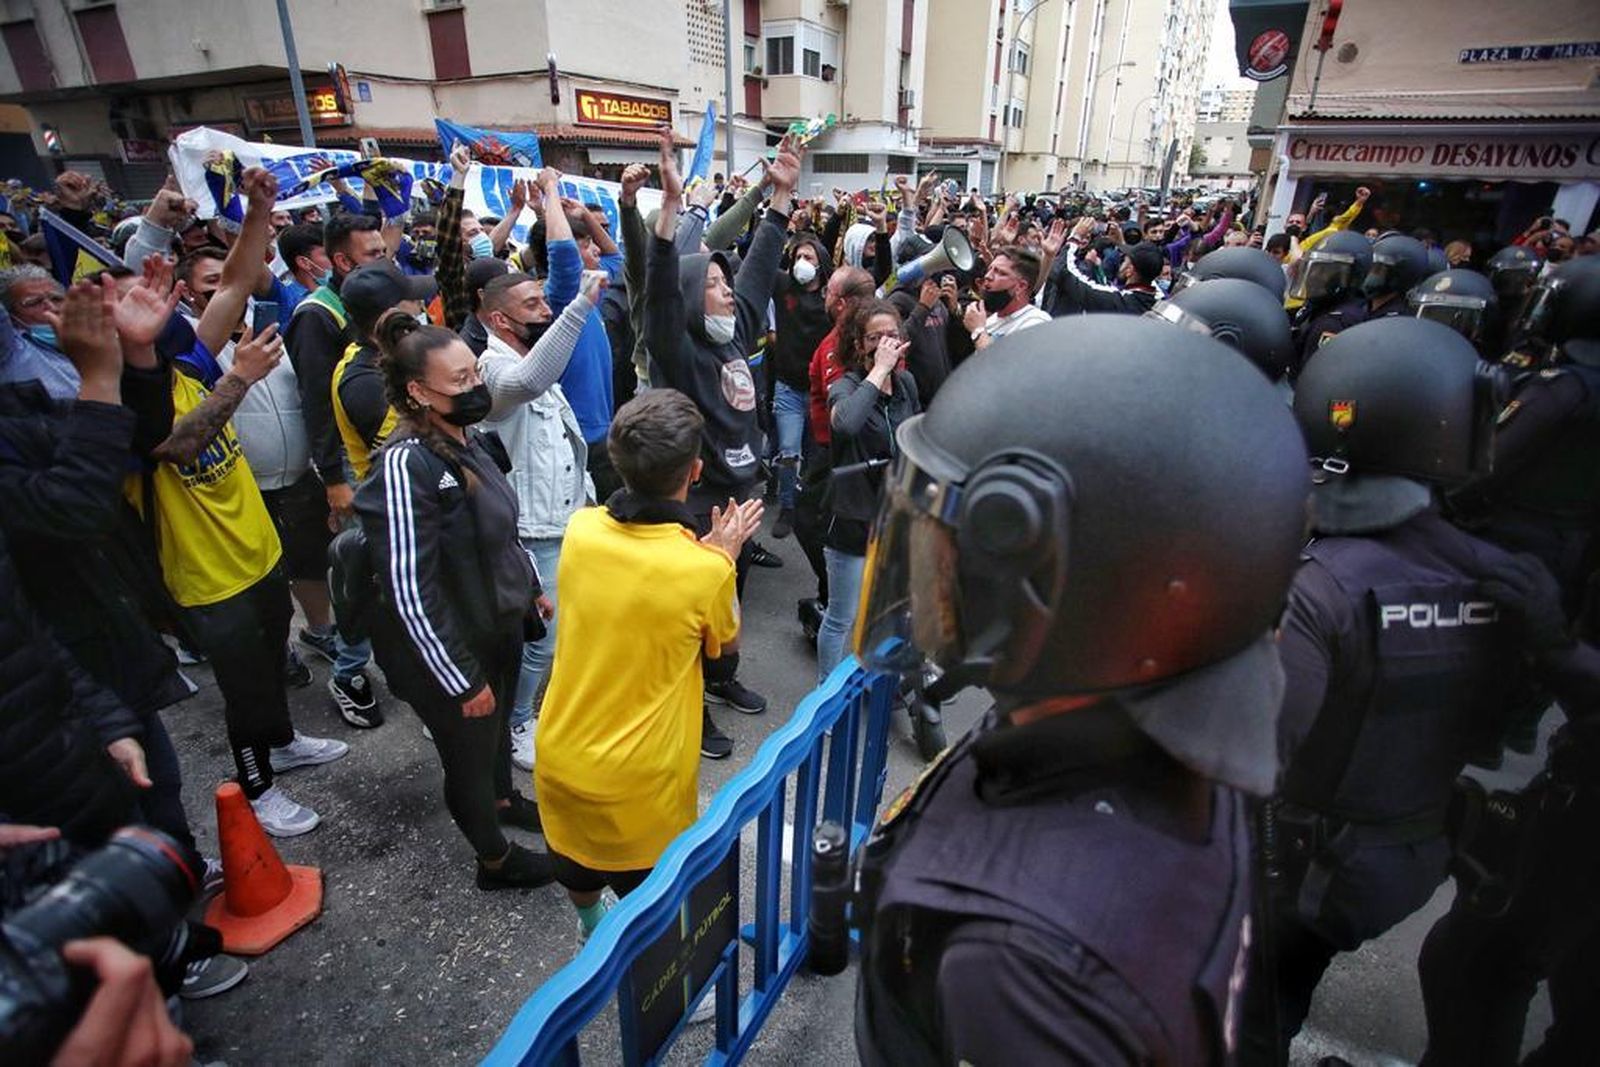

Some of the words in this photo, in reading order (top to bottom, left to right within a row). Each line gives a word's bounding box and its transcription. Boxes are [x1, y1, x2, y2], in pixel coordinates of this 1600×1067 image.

[1460, 49, 1509, 63] PLAZA
[1521, 47, 1541, 60] DE
[600, 98, 669, 119] TABACOS
[1289, 138, 1425, 167] Cruzcampo
[1430, 143, 1579, 168] DESAYUNOS
[1381, 601, 1499, 629] POLIC
